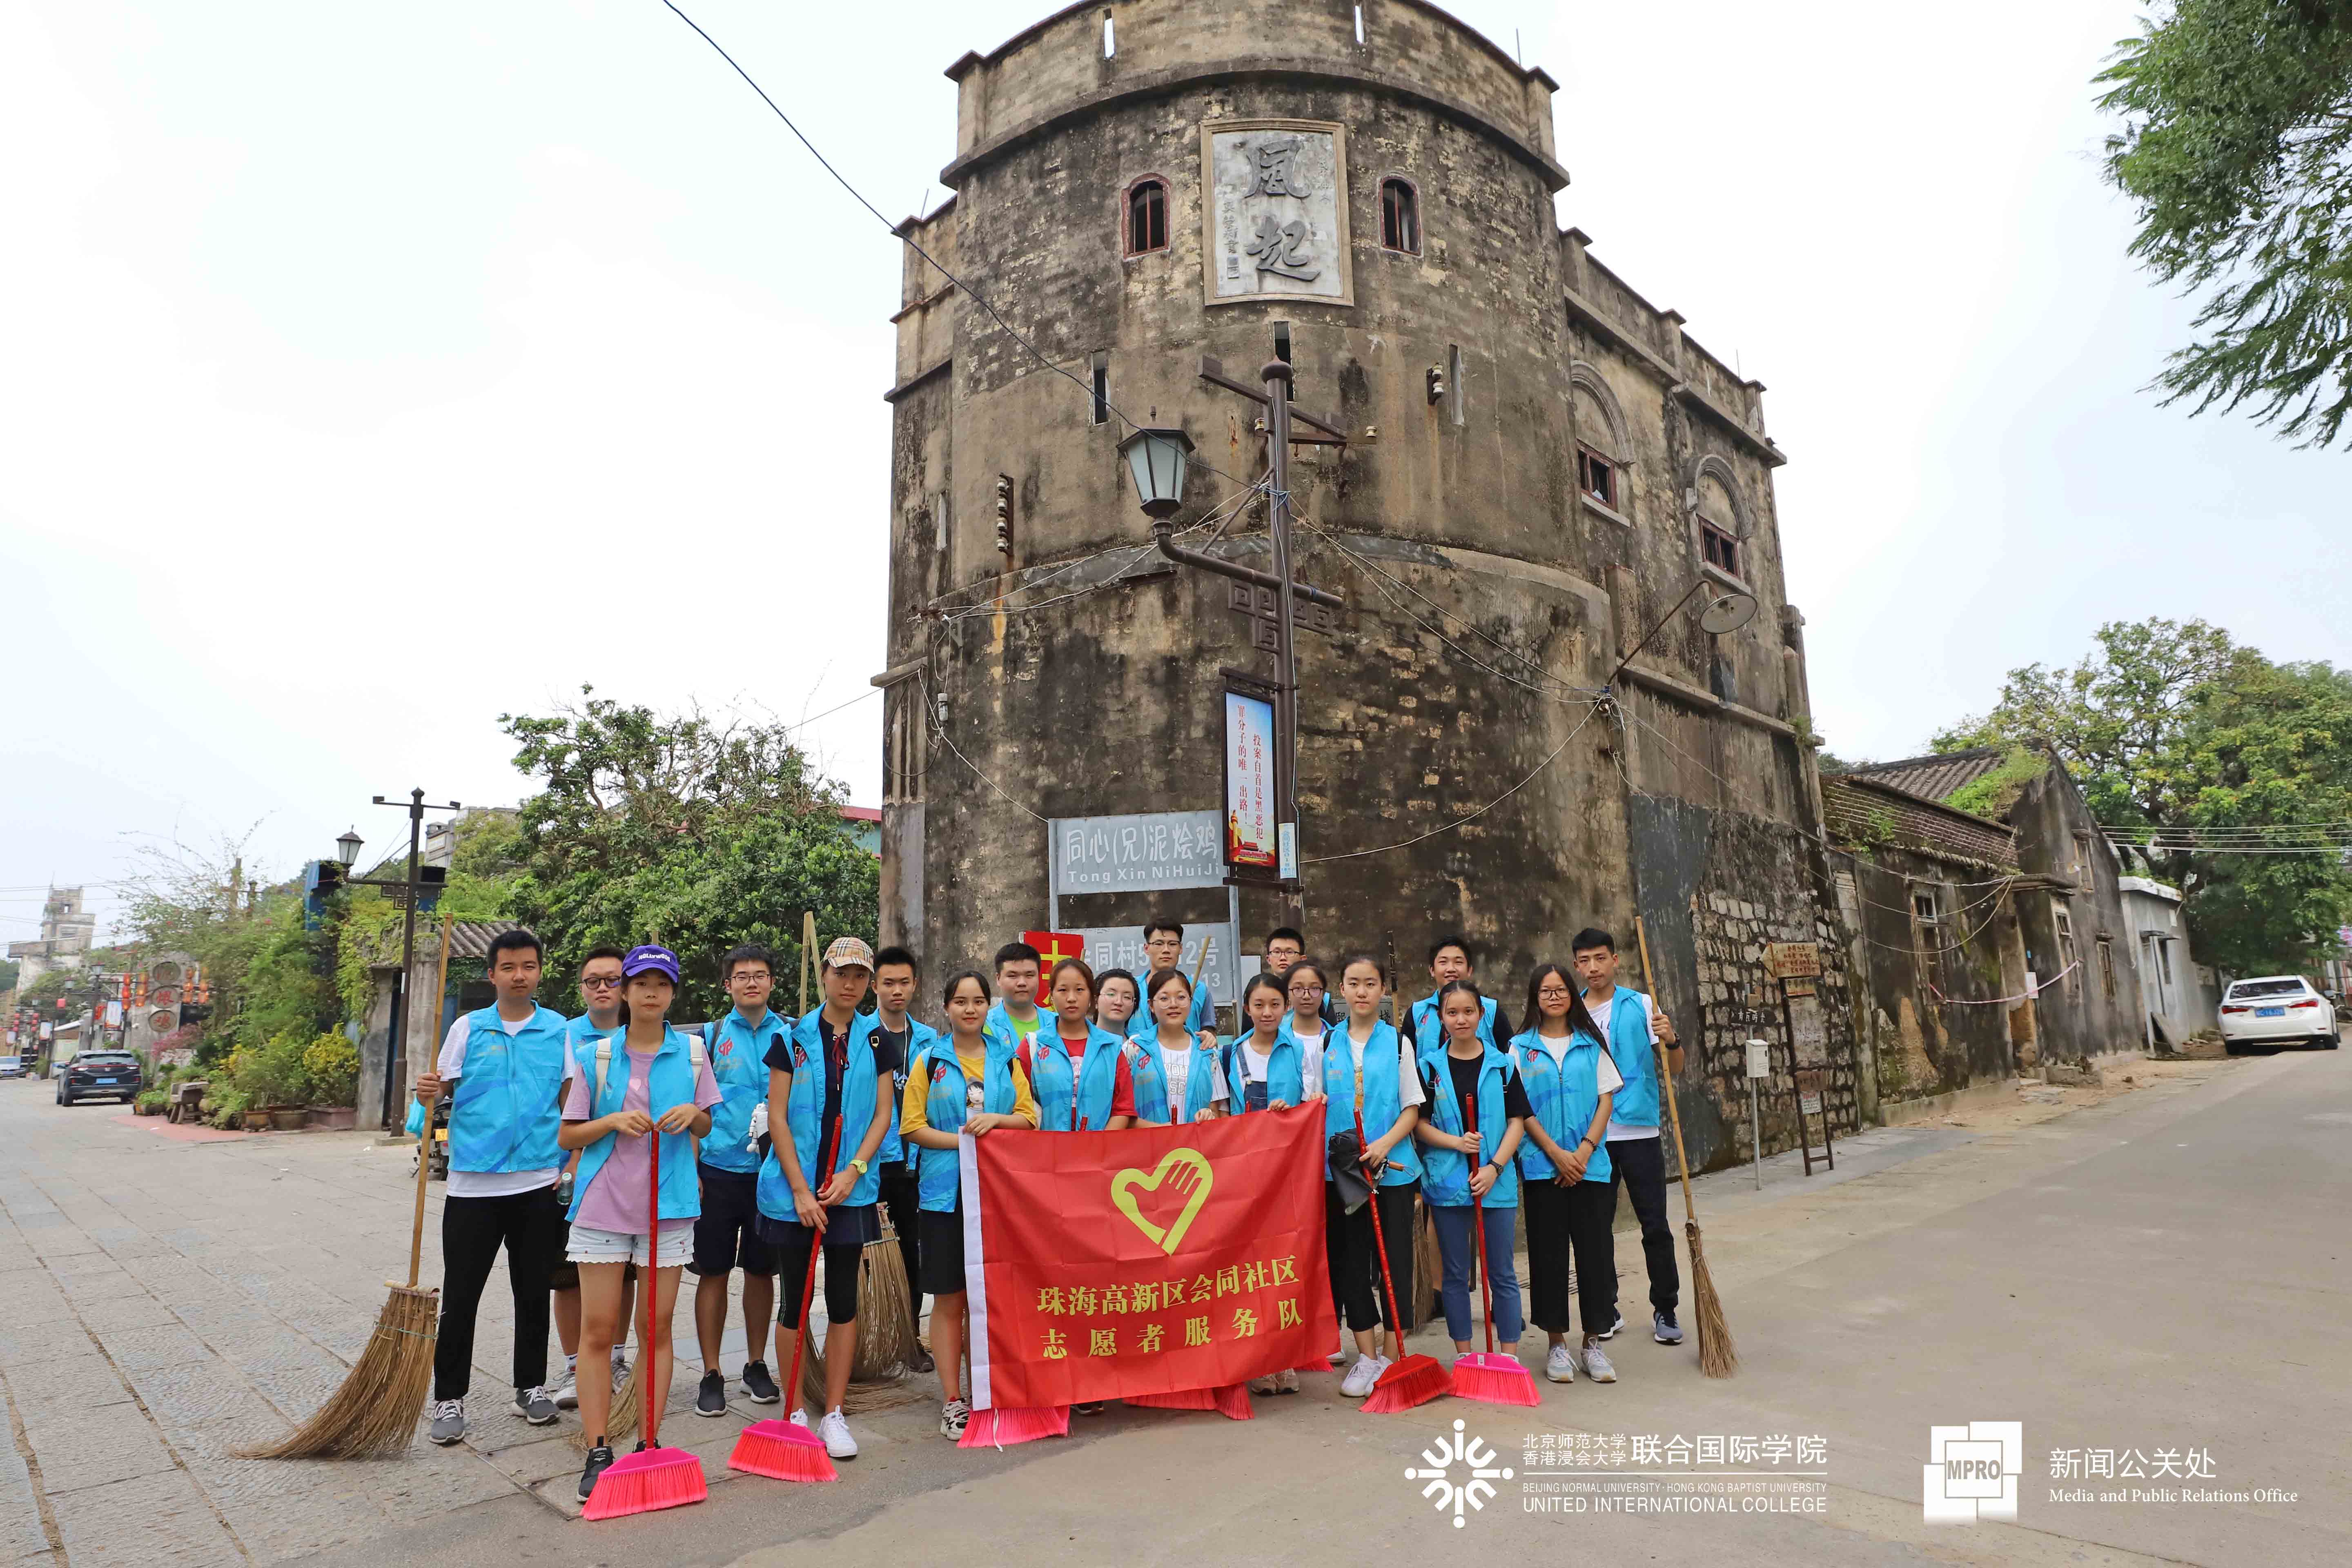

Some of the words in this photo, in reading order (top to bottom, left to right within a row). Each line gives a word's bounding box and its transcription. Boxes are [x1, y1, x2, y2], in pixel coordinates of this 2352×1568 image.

[1237, 705, 1248, 825] 罪分子的唯一出路！
[1252, 733, 1264, 840] 投案自首是黑恶犯
[1068, 871, 1111, 884] Tong
[1117, 867, 1146, 881] Xin
[638, 953, 671, 962] HOLLYWOOD
[1037, 1254, 1300, 1317] 珠海高新区会同社区
[1040, 1298, 1303, 1359] 志愿者服务队
